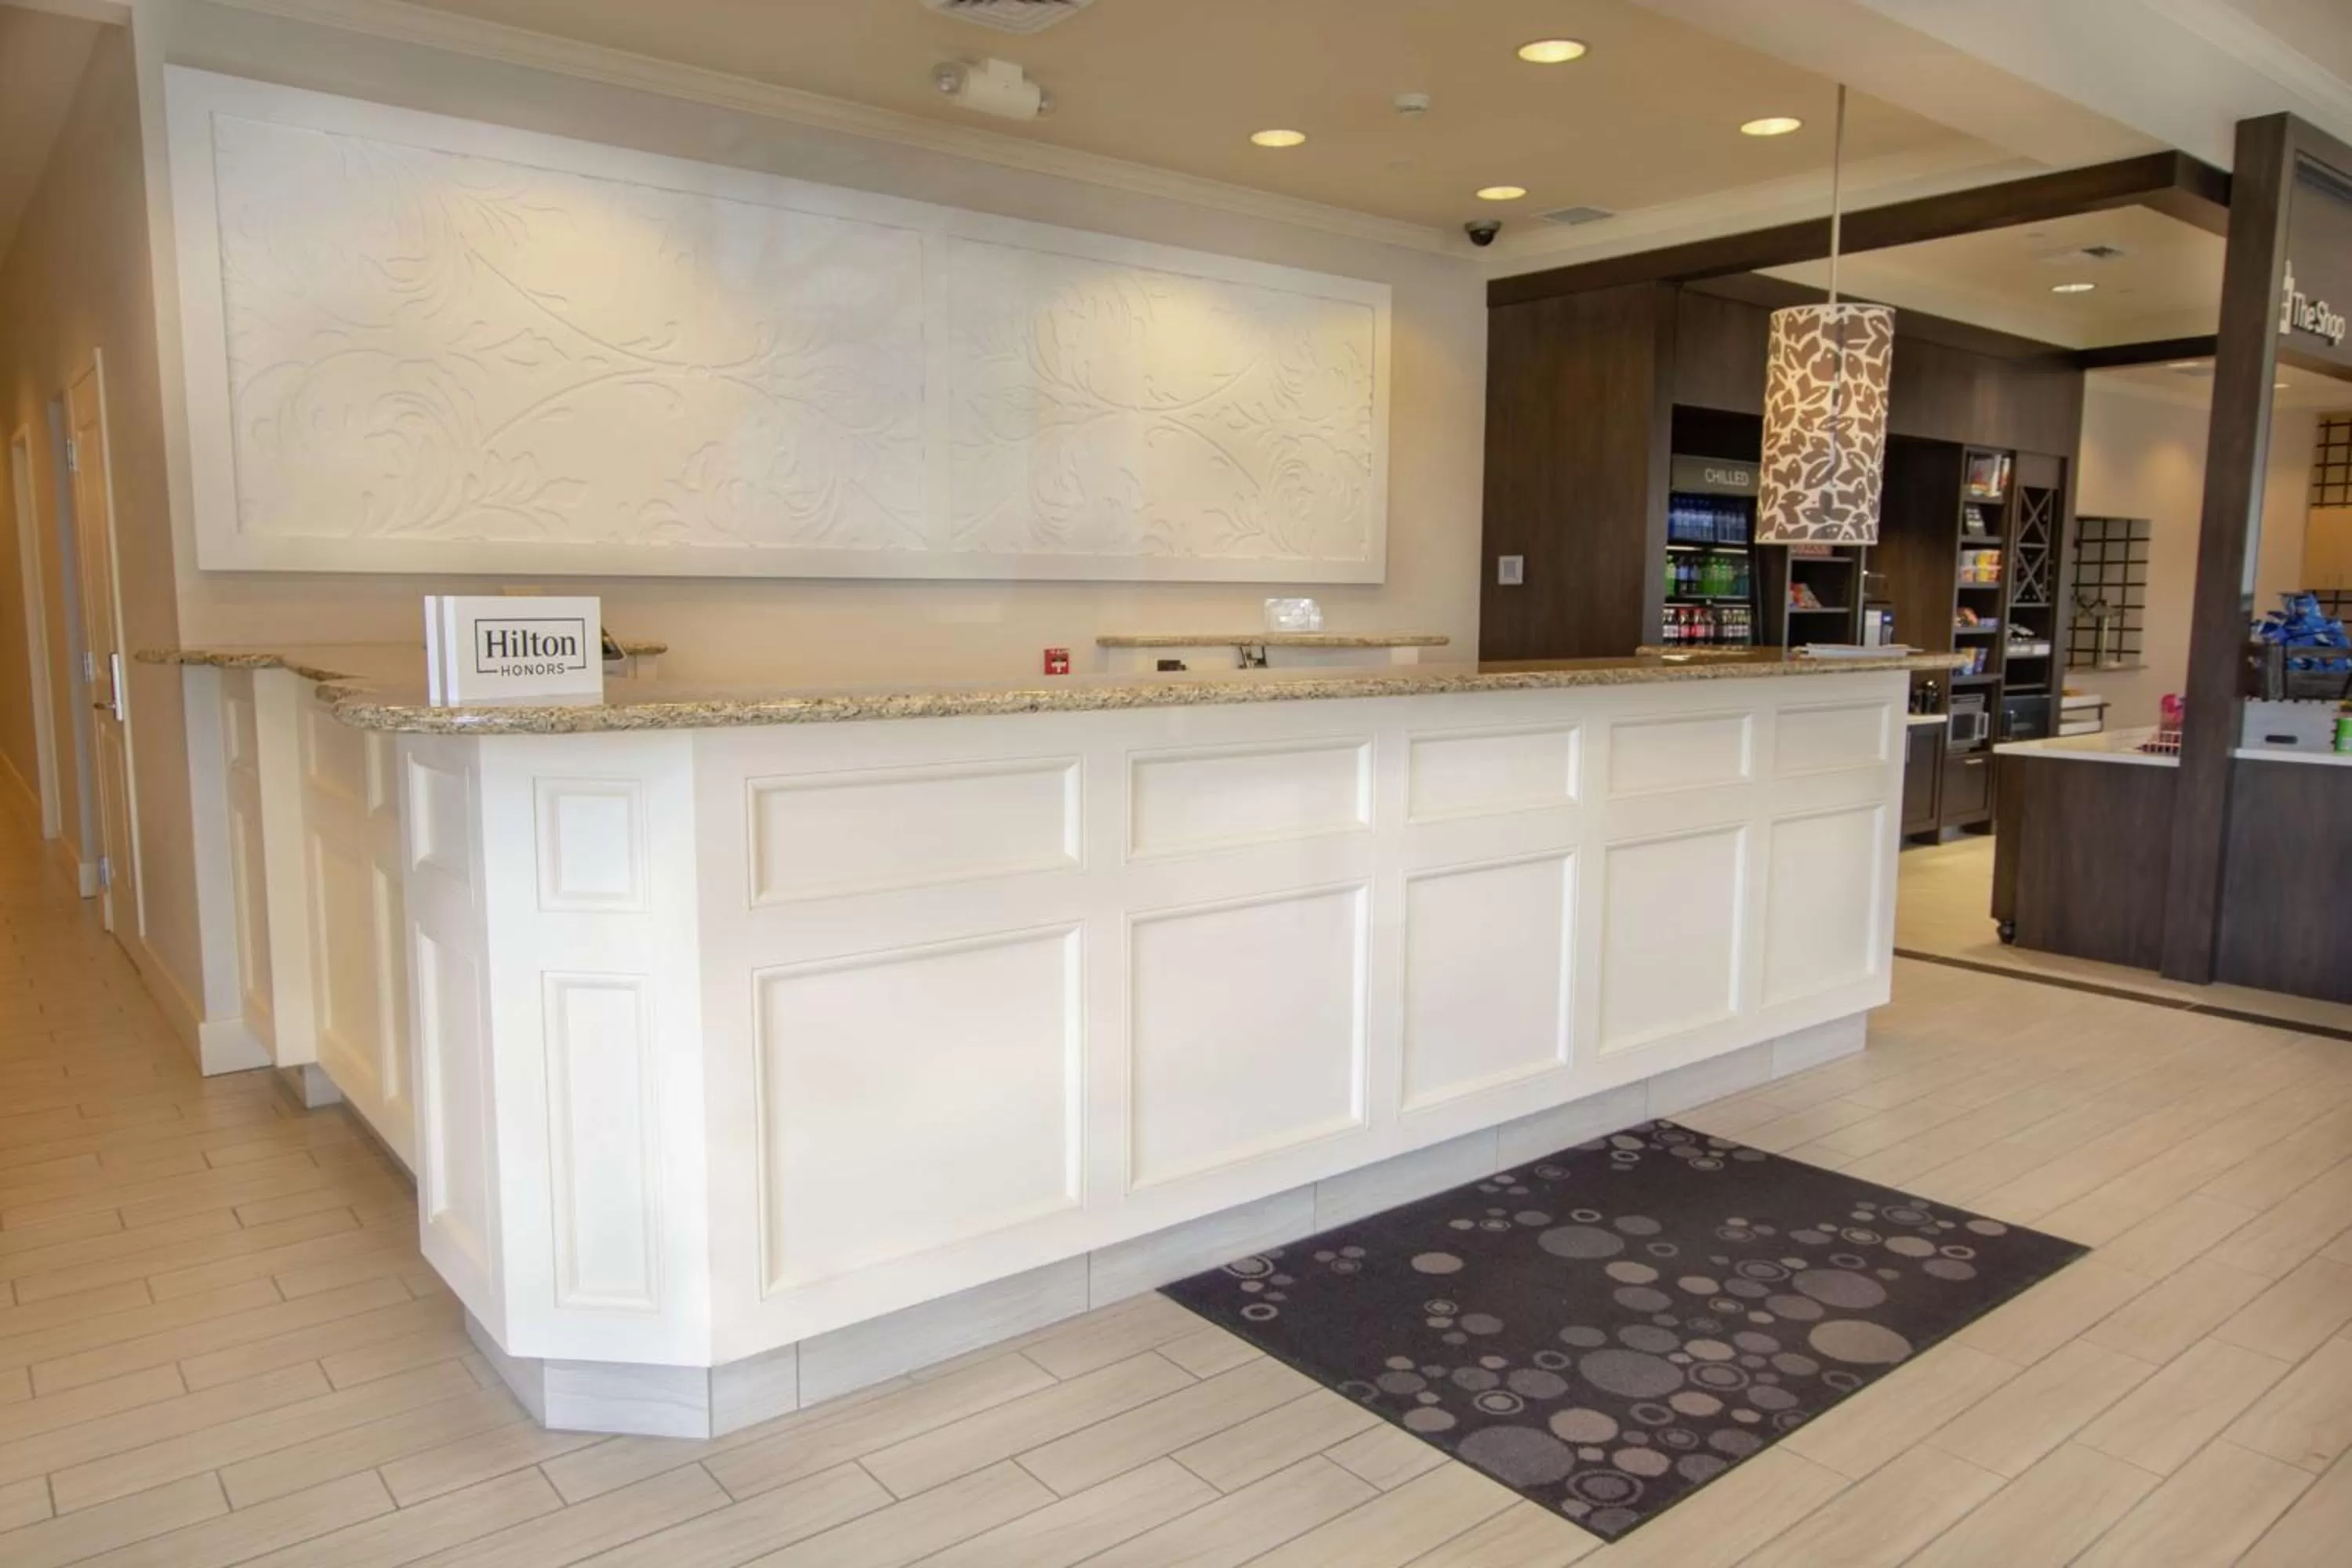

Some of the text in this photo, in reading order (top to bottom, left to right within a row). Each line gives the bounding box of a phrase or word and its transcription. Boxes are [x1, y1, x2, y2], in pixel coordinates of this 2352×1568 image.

[2292, 291, 2346, 346] The Shop
[1705, 468, 1750, 486] CHILLED
[485, 629, 577, 658] Hilton
[501, 662, 565, 677] HONORS
